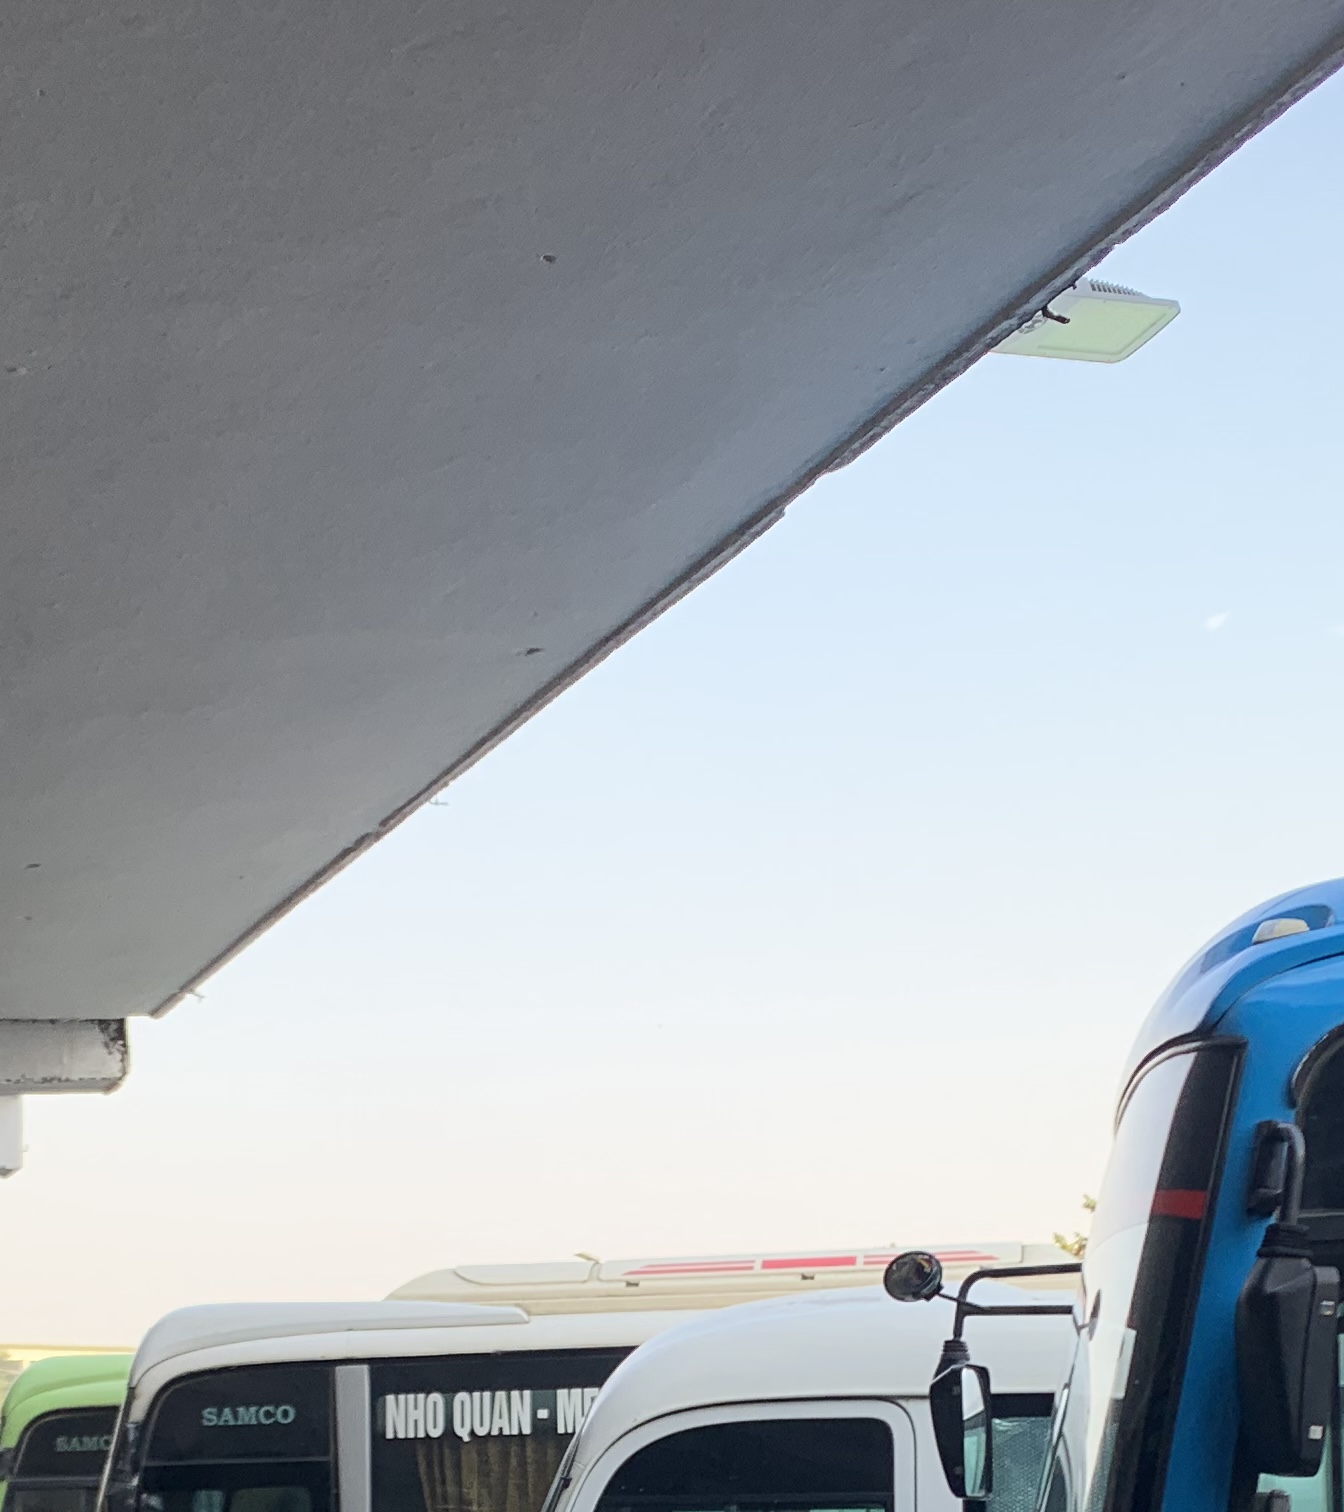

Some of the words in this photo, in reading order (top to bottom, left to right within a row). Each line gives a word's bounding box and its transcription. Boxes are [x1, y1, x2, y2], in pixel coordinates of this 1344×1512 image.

[200, 1404, 297, 1427] SAMCO
[384, 1392, 445, 1440] NHO
[452, 1390, 533, 1442] QUAN
